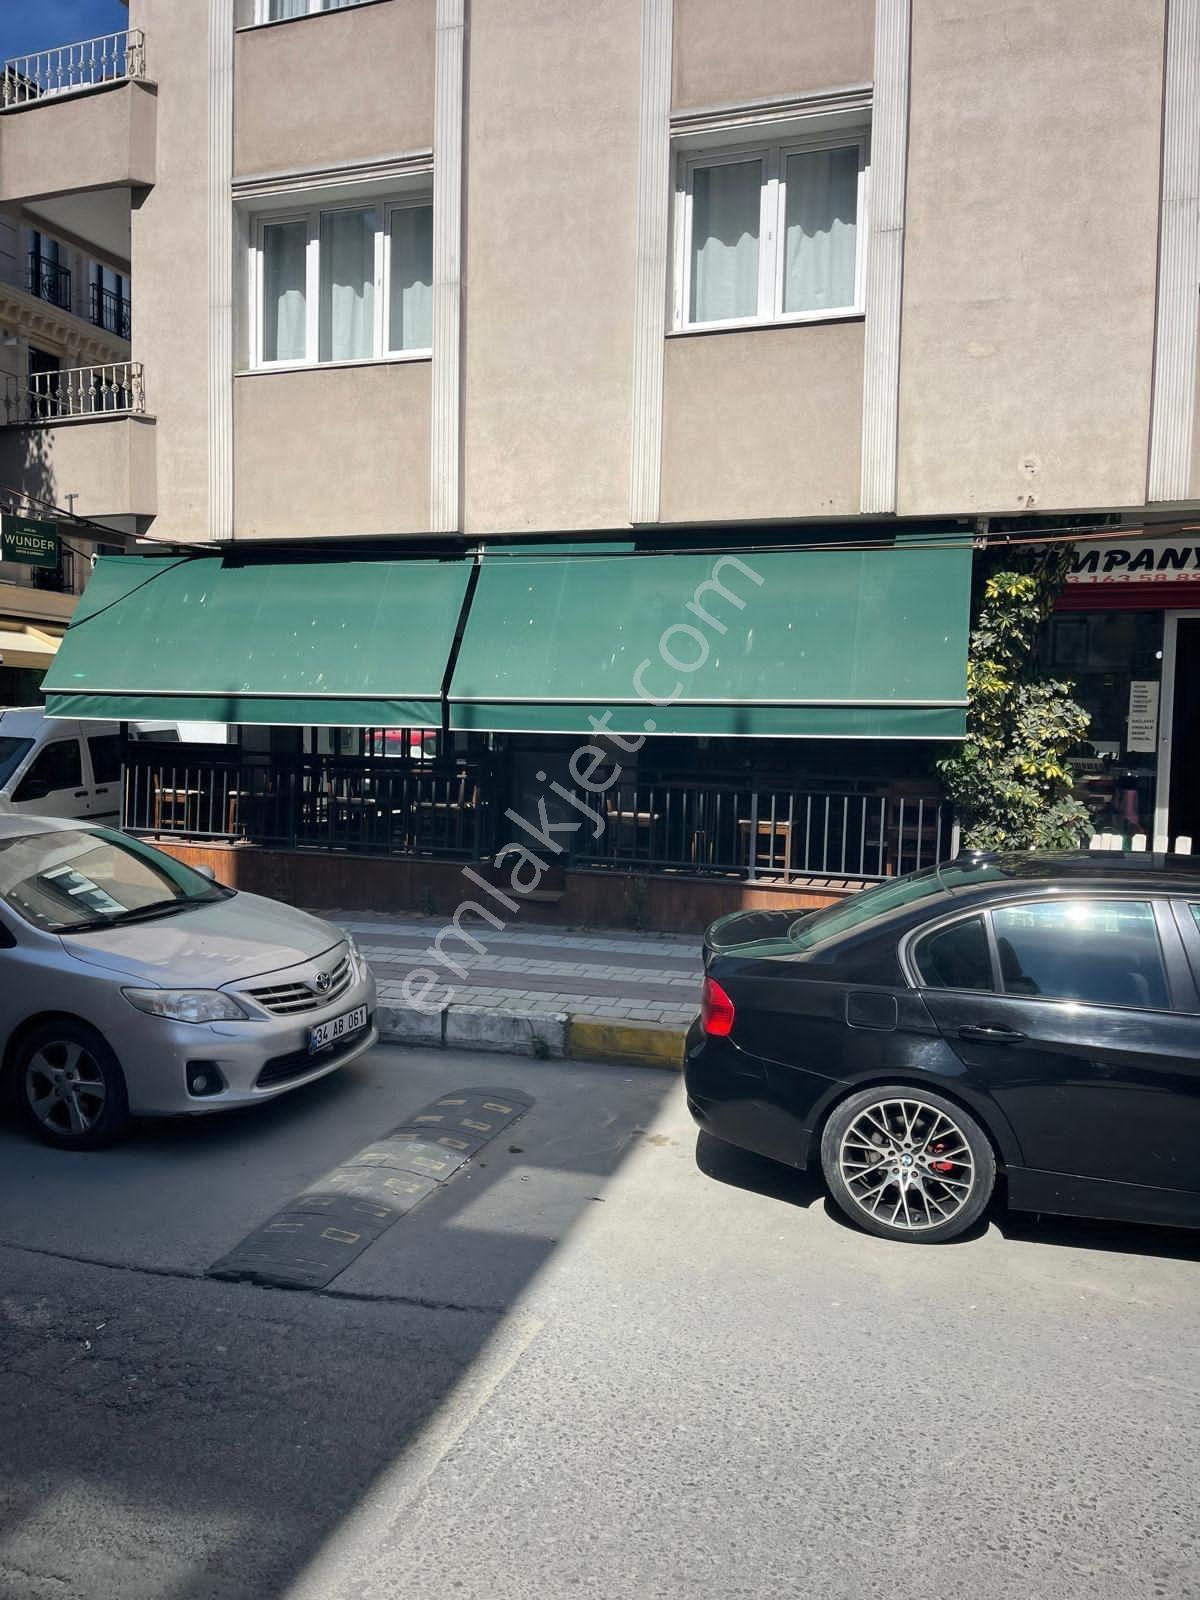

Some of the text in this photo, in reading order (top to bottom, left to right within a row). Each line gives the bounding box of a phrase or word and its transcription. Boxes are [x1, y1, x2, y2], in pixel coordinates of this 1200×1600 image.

[4, 533, 55, 550] WUNDER
[1046, 547, 1200, 573] MPAN
[317, 1010, 364, 1043] 34 AB 061
